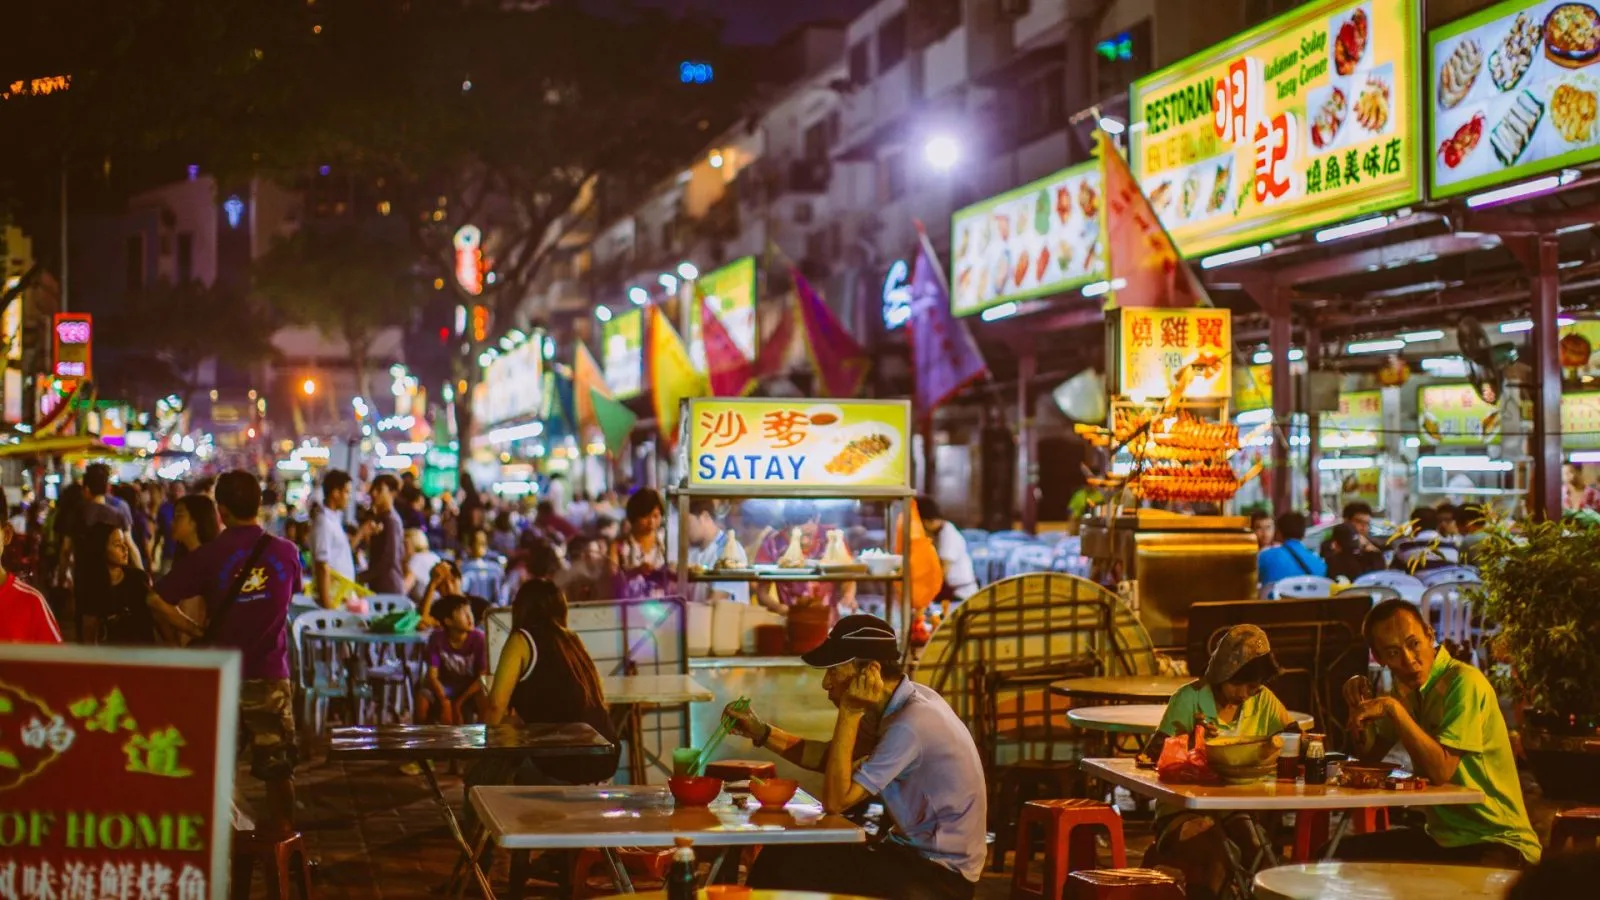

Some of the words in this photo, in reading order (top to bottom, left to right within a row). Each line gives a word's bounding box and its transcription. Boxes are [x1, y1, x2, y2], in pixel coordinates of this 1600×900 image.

[1300, 30, 1327, 60] Sedap
[1300, 58, 1328, 86] Corner
[1145, 77, 1215, 135] RESTORAN
[1306, 137, 1401, 195] 燒魚美味店
[698, 454, 806, 481] SATAY
[0, 810, 57, 848] OF
[65, 811, 206, 852] HOME
